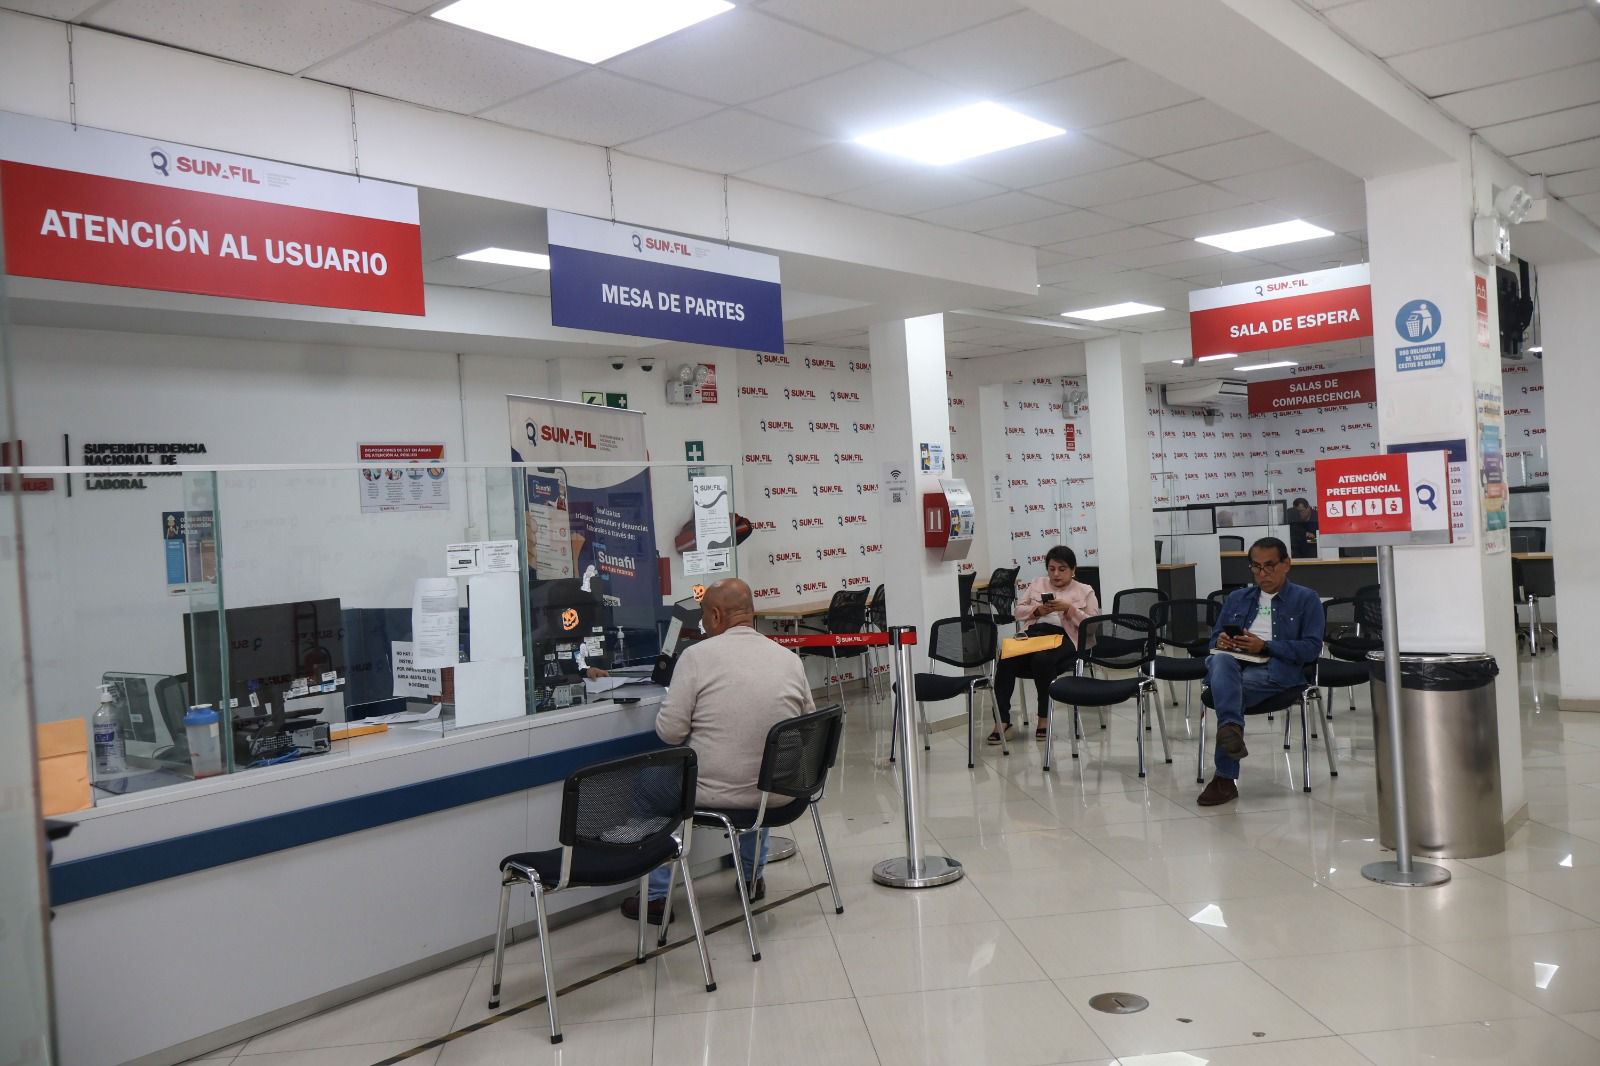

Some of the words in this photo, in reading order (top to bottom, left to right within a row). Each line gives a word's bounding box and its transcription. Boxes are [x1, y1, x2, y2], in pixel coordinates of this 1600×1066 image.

[40, 209, 209, 256] ATENCIÓN
[219, 233, 257, 261] AL
[265, 239, 388, 276] USUARIO
[602, 283, 653, 309] MESA
[658, 292, 681, 313] DE
[685, 297, 745, 322] PARTES
[1230, 321, 1268, 338] SALA
[1272, 318, 1293, 333] DE
[1297, 308, 1360, 329] ESPERA
[1289, 380, 1322, 393] SALAS
[1324, 379, 1338, 389] DE
[1272, 390, 1361, 408] COMPARECENCIA
[84, 443, 207, 454] SUPERINTENDENCIA
[84, 454, 153, 465] NACIONAL
[160, 454, 177, 465] DE
[86, 478, 148, 490] LABORAL
[1338, 471, 1387, 484] ATENCIÓN
[1326, 485, 1401, 497] PREFERENCIAL
[598, 551, 636, 570] Sunafil
